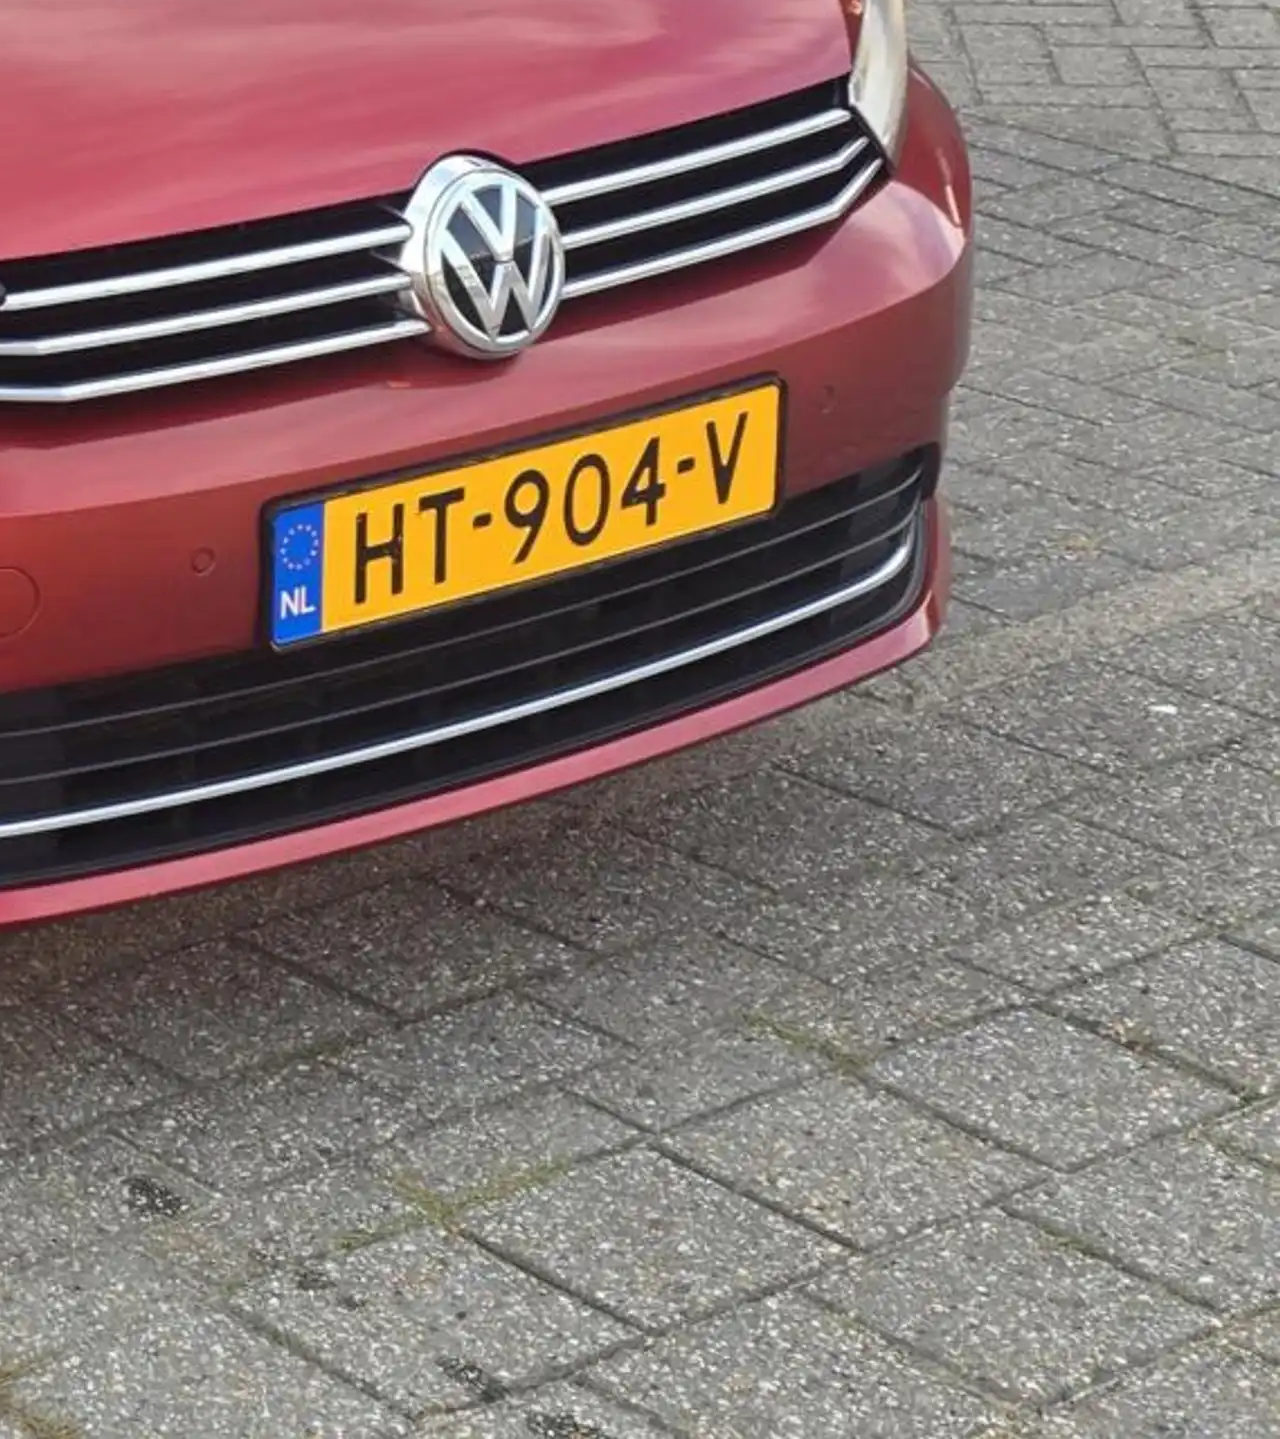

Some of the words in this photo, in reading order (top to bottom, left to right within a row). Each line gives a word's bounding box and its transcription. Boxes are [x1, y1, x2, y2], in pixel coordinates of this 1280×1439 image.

[436, 179, 554, 340] VW
[354, 412, 749, 605] HT-904-V
[280, 586, 315, 620] NL
